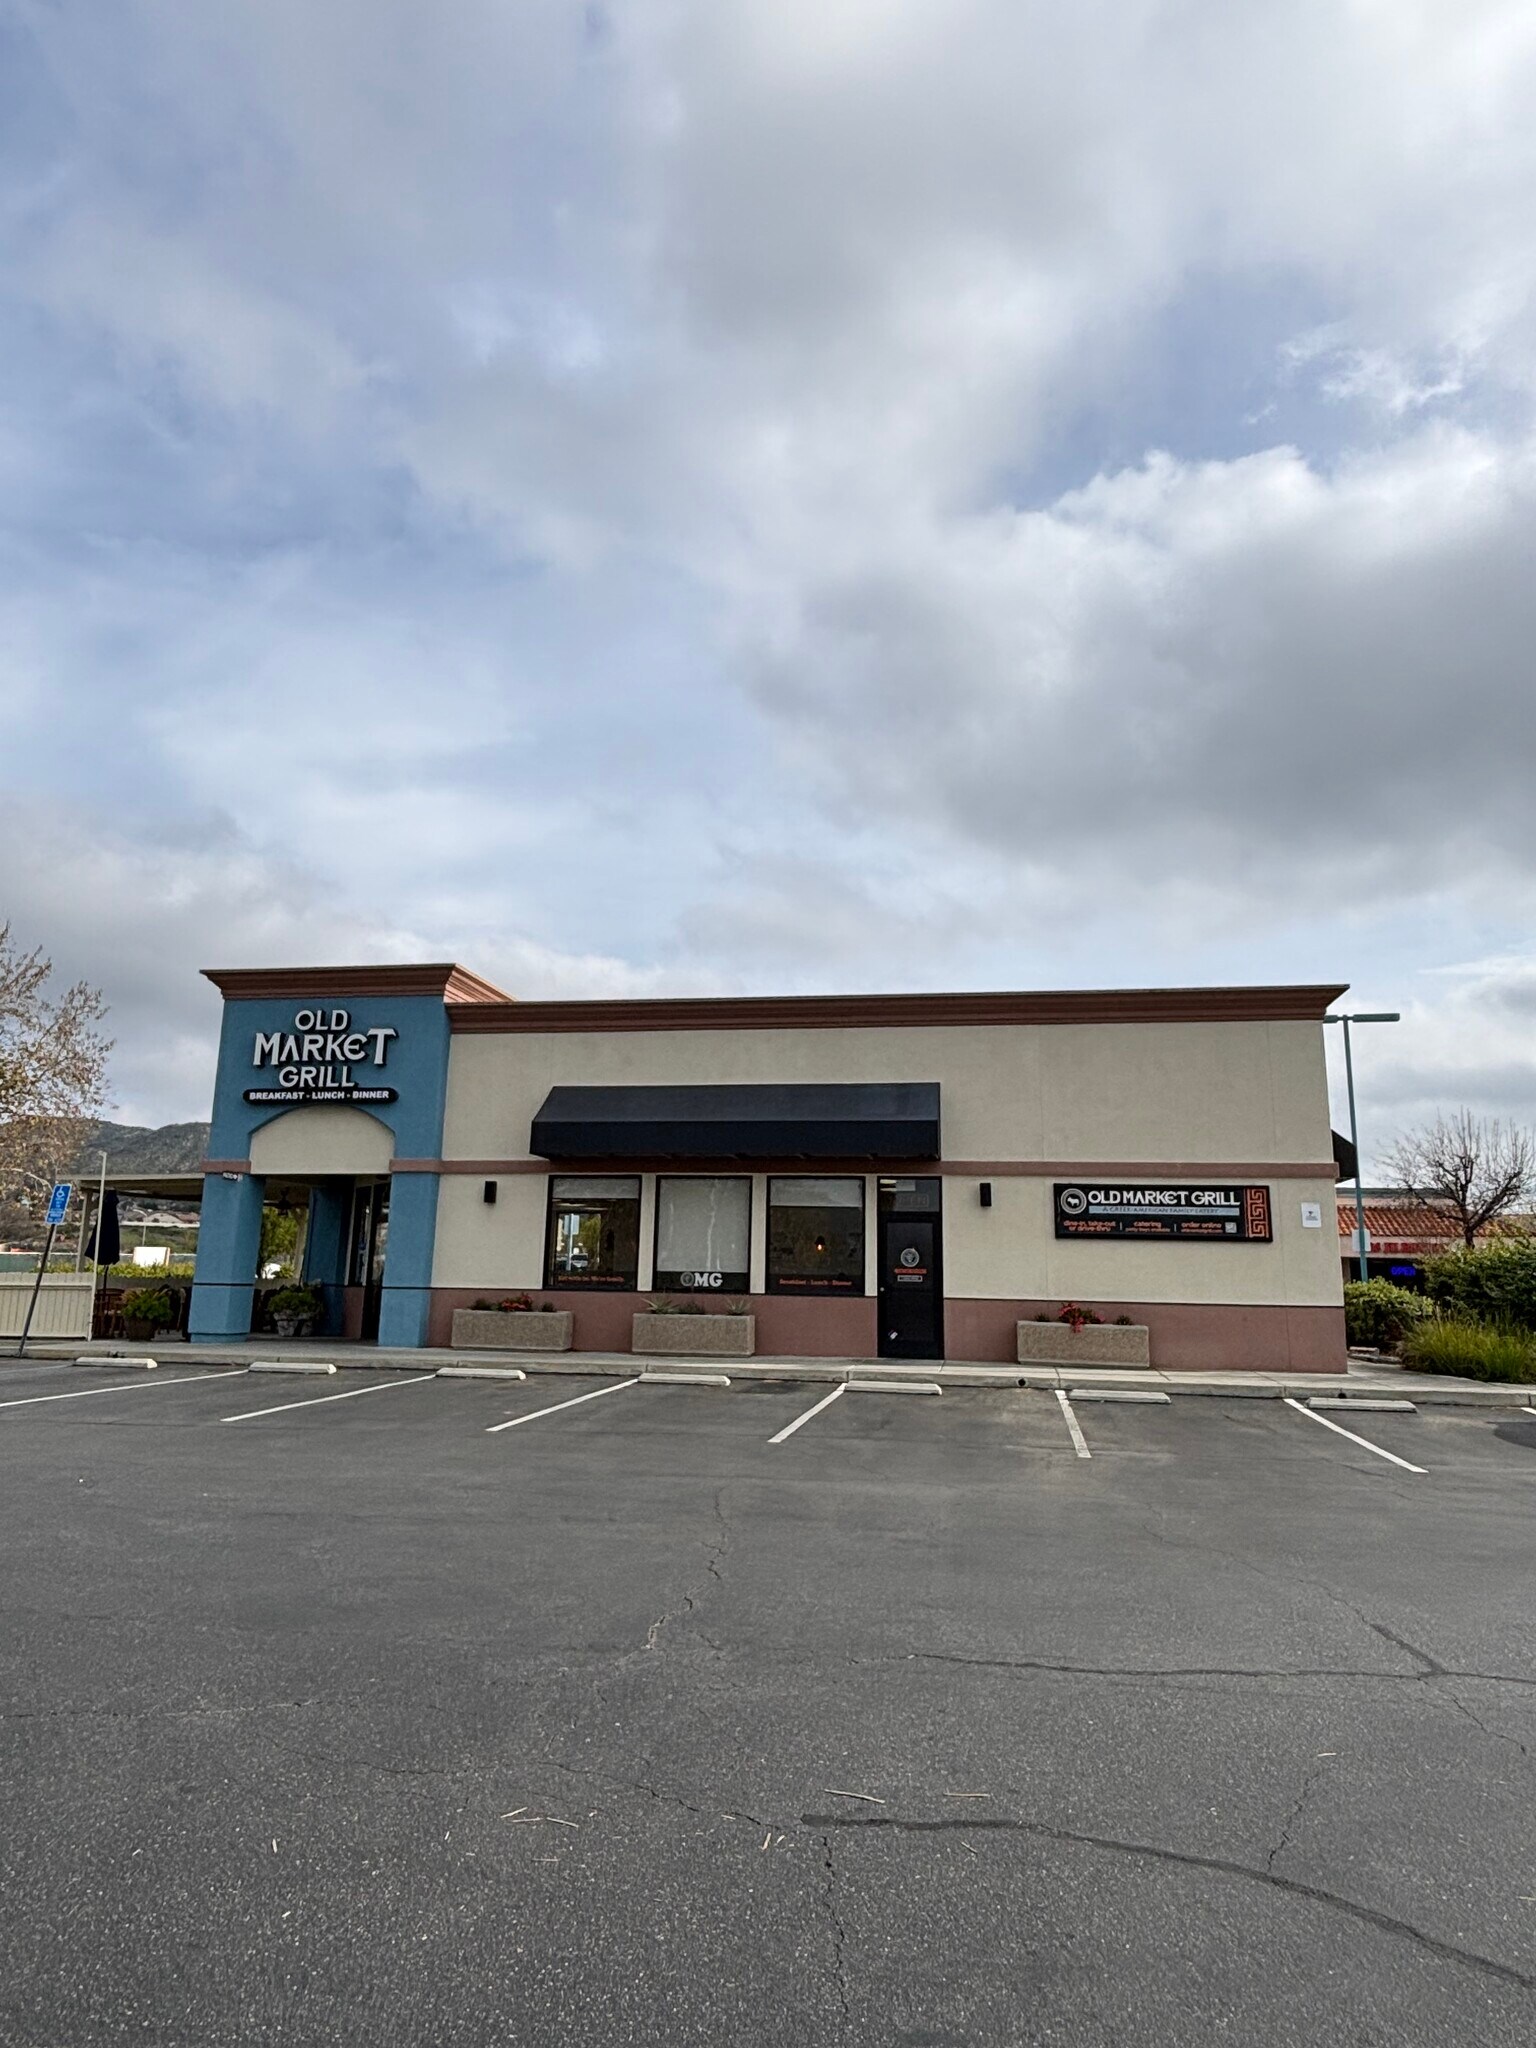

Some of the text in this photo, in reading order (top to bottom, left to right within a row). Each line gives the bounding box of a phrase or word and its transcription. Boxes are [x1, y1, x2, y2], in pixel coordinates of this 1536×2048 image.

[294, 1009, 349, 1031] OLD
[252, 1028, 397, 1066] MARKET
[278, 1065, 356, 1088] GRILL
[249, 1090, 390, 1100] BREAKFAST LUNCH DINNER
[1087, 1190, 1241, 1206] OLD MARKET GRILL
